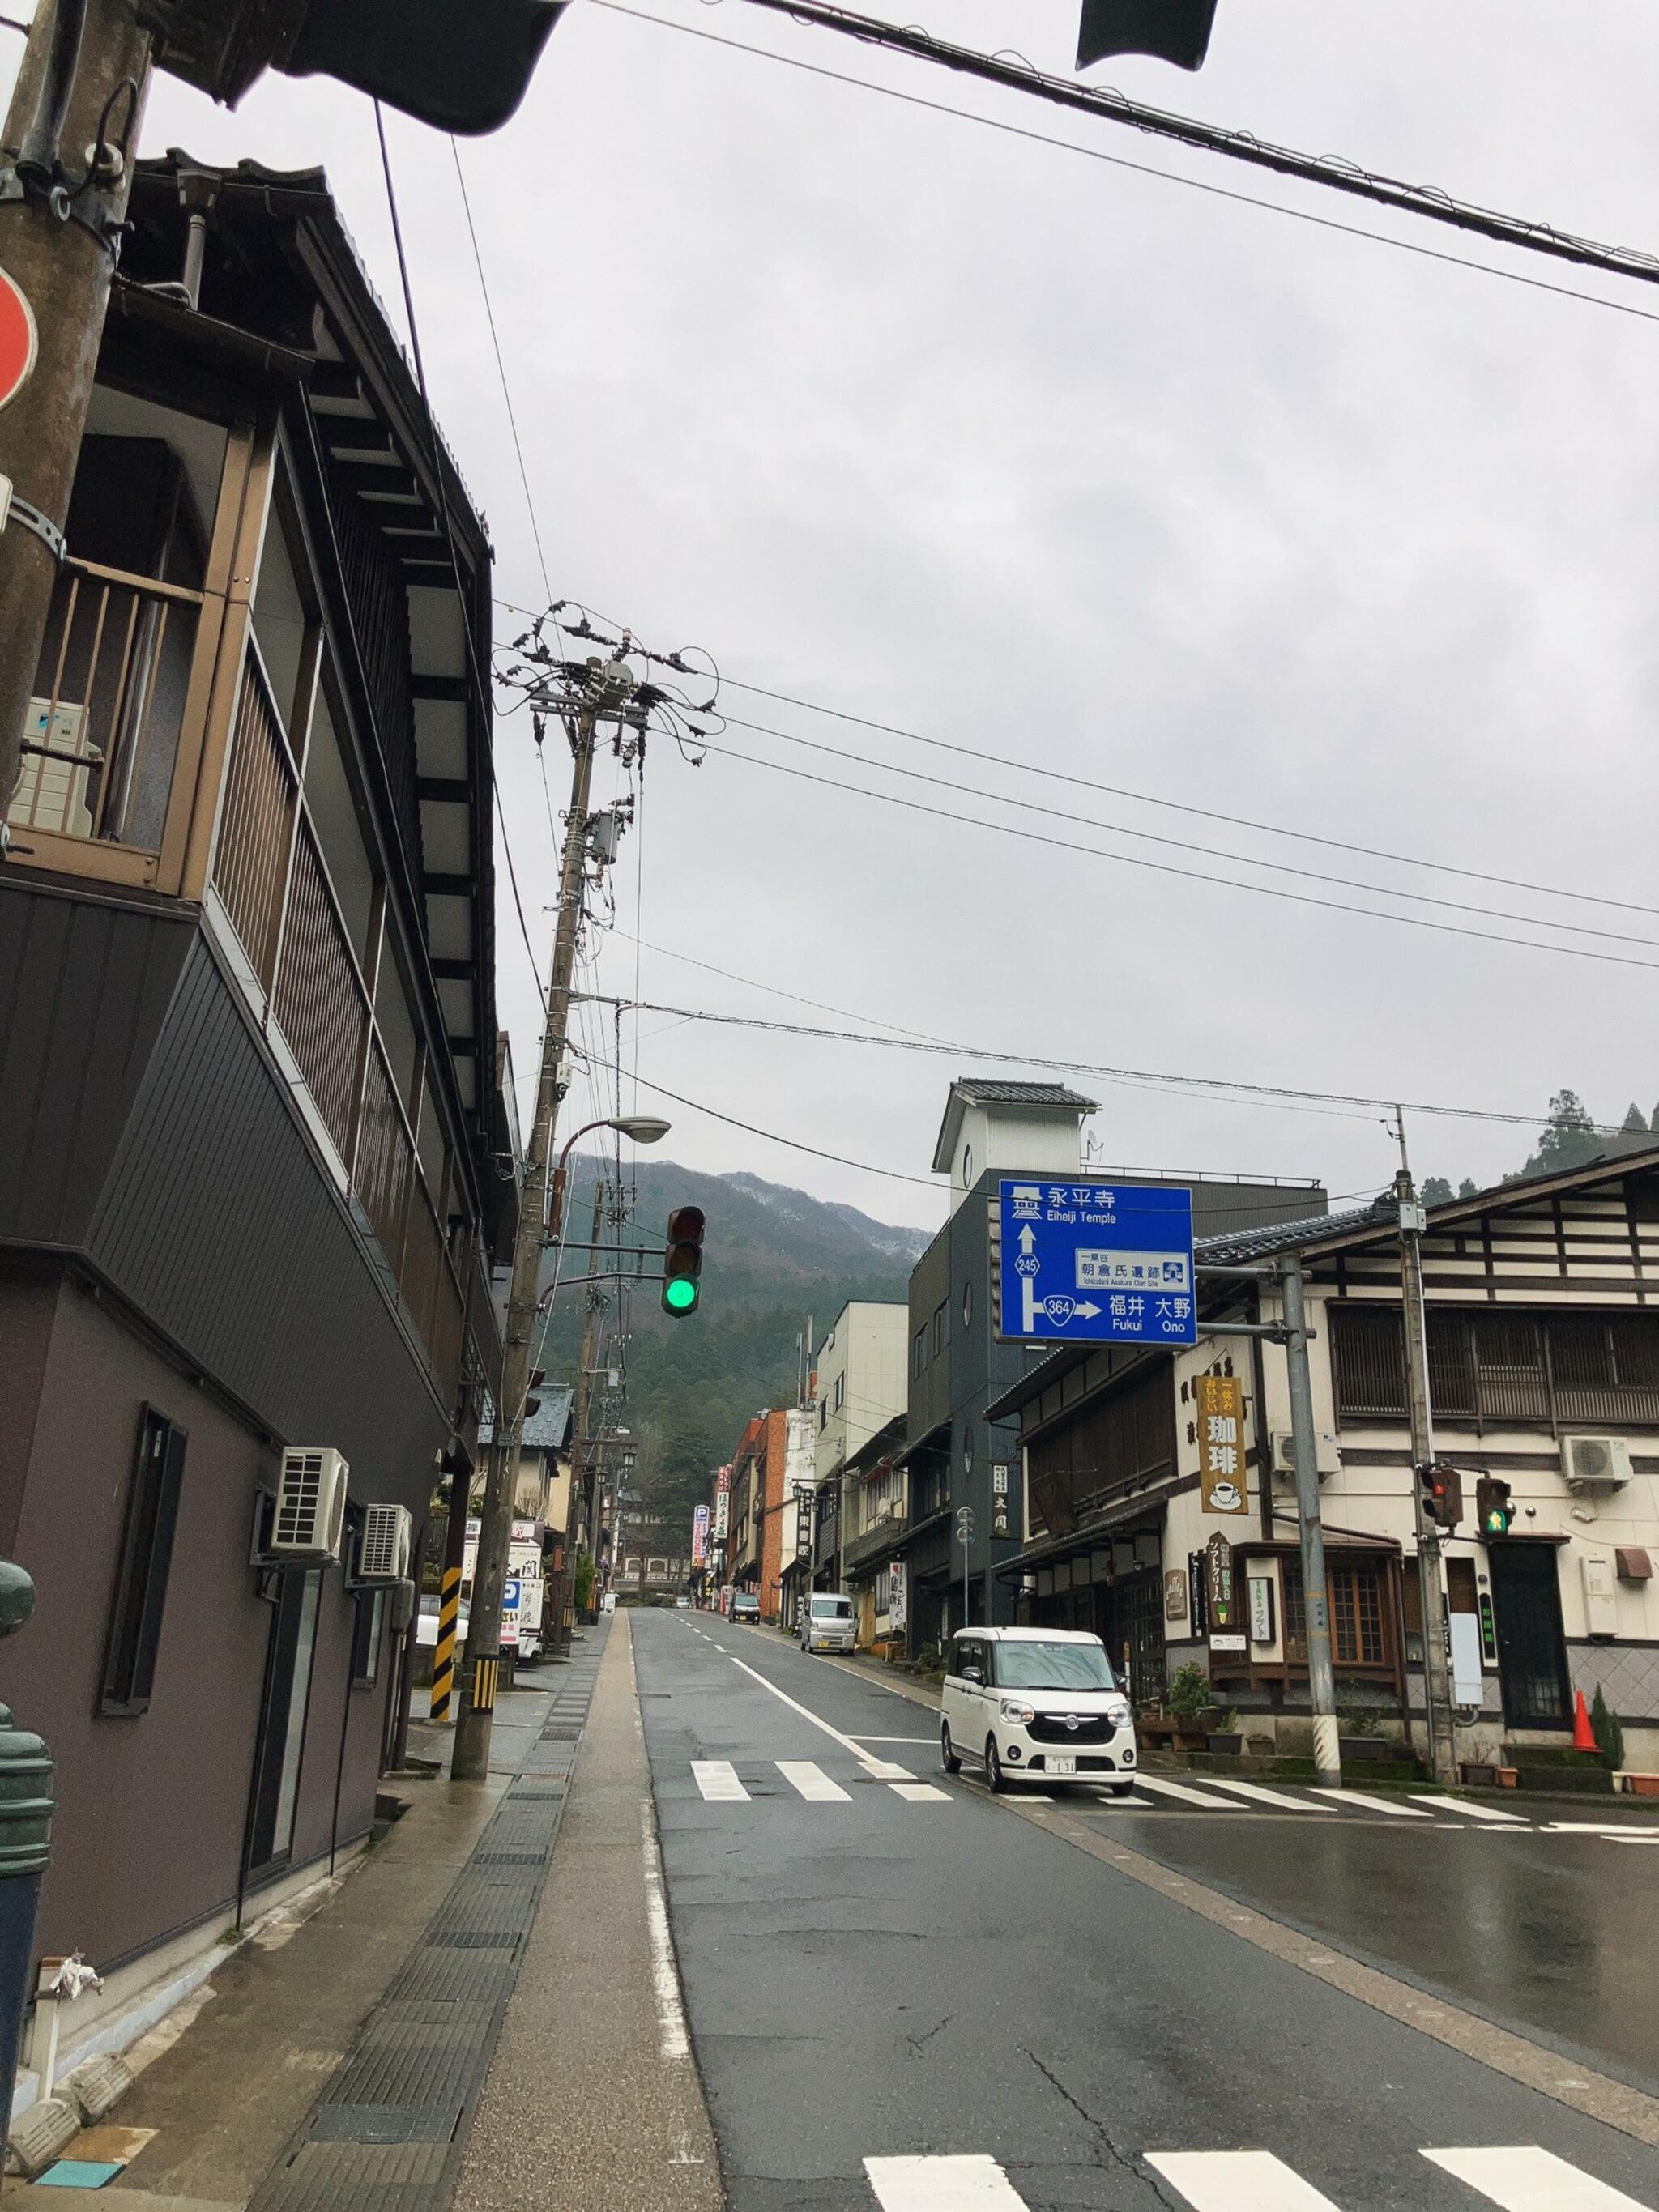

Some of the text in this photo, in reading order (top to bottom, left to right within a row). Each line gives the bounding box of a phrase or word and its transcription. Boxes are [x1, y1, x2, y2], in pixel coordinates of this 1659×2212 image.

[1048, 1187, 1115, 1208] 永平寺
[1047, 1209, 1116, 1226] Eiheiji Temple
[1018, 1259, 1037, 1272] 245
[1081, 1263, 1161, 1279] 朝倉氏遺跡
[1048, 1300, 1070, 1315] 364
[1109, 1294, 1191, 1319] 福井 大野
[1112, 1318, 1186, 1332] Fukui Ono
[1205, 1378, 1218, 1412] おいしい
[1207, 1415, 1238, 1474] 珈琲
[1209, 1541, 1222, 1602] ソフトクリーム
